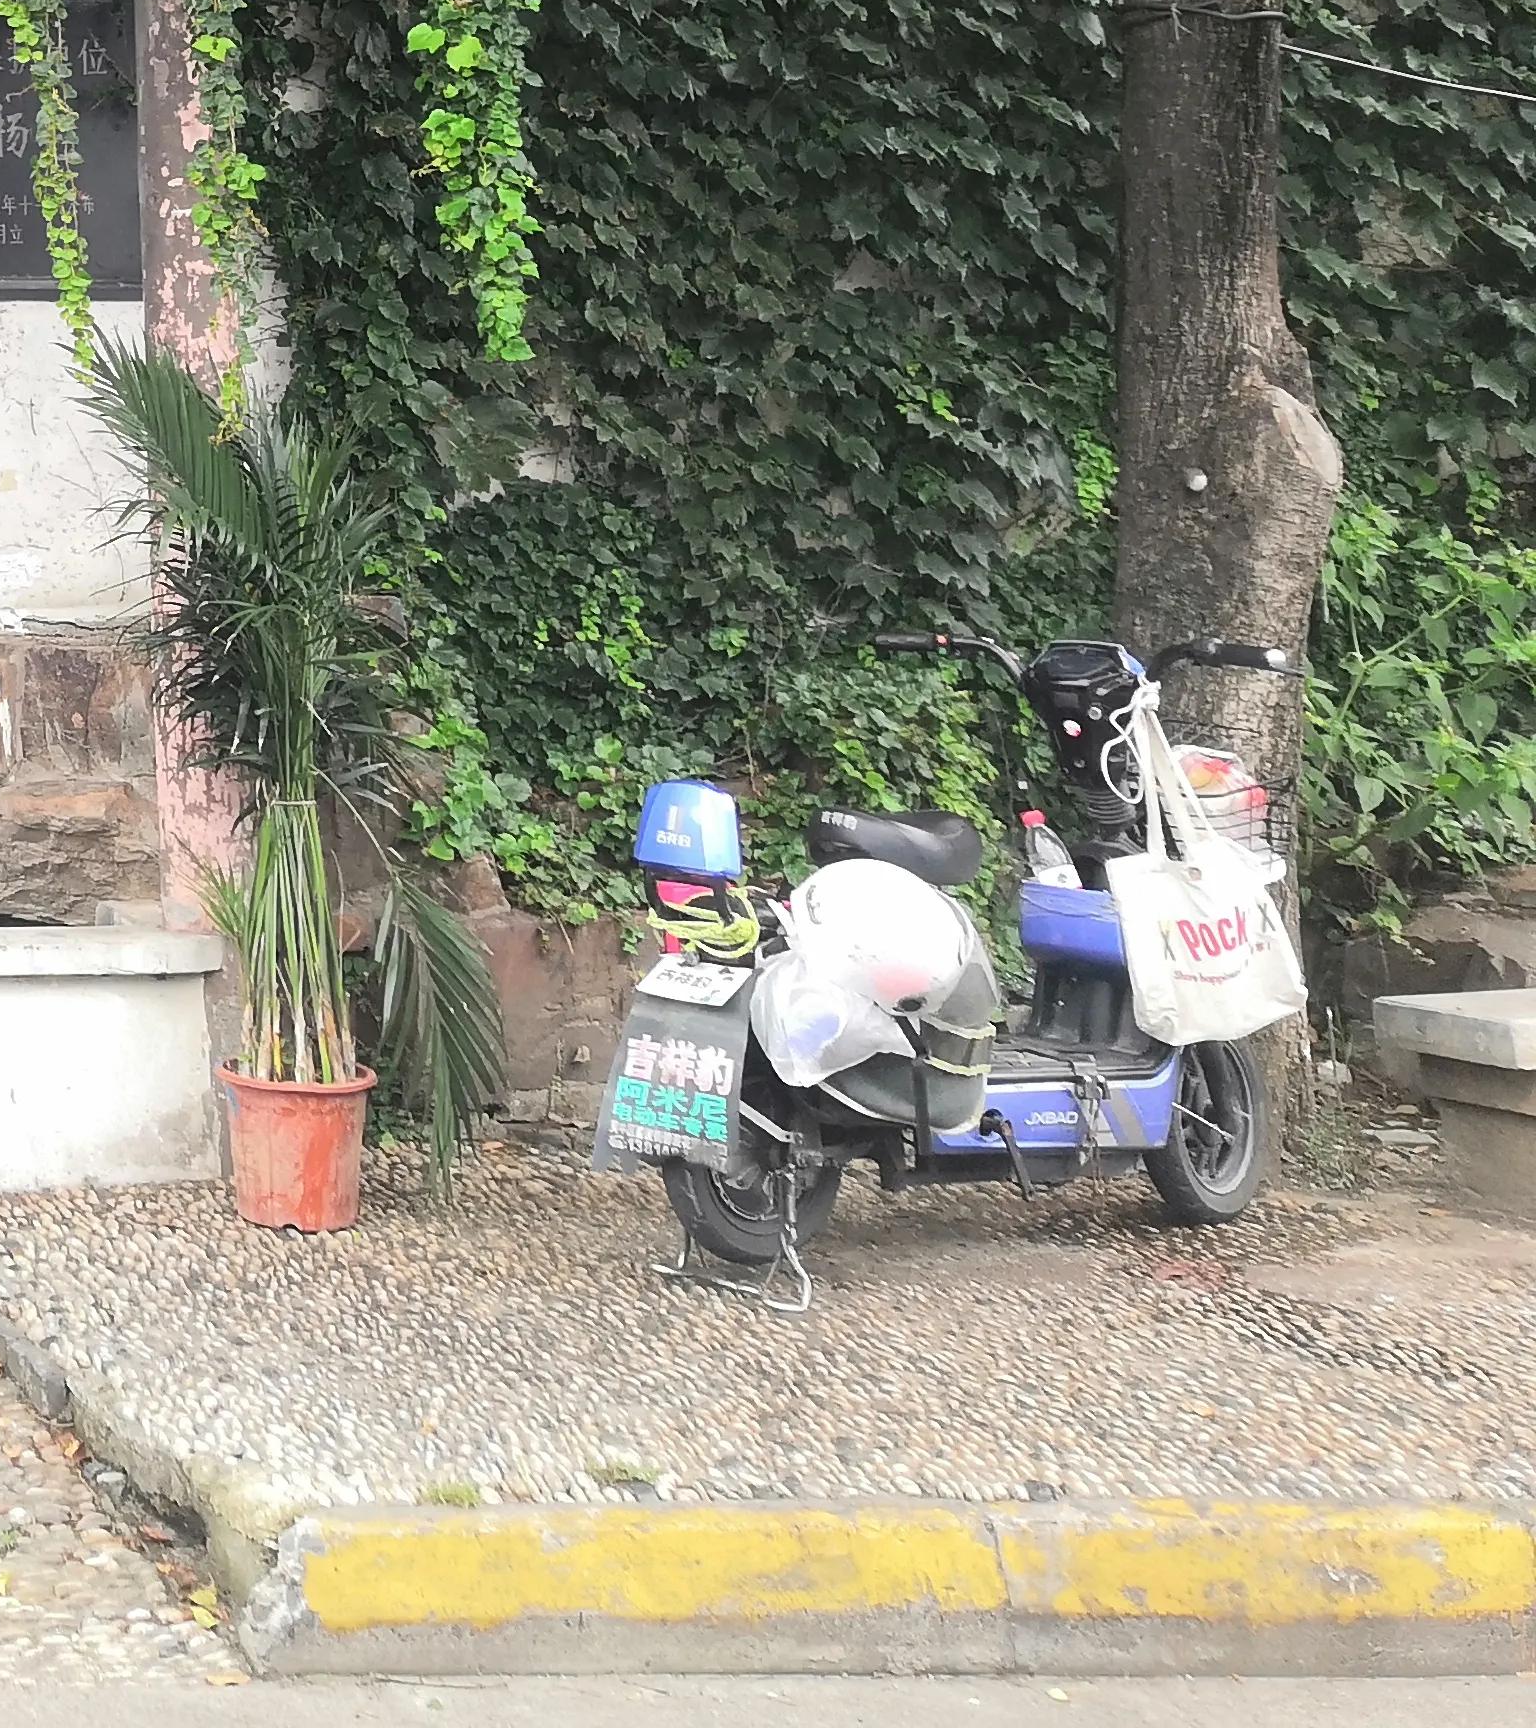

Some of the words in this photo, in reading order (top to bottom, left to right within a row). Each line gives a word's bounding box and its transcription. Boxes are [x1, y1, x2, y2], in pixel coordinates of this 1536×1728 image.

[1176, 905, 1253, 962] Pock
[623, 1034, 735, 1096] 吉祥豹
[612, 1102, 728, 1143] 电动车专卖
[615, 1076, 728, 1123] 阿米尼
